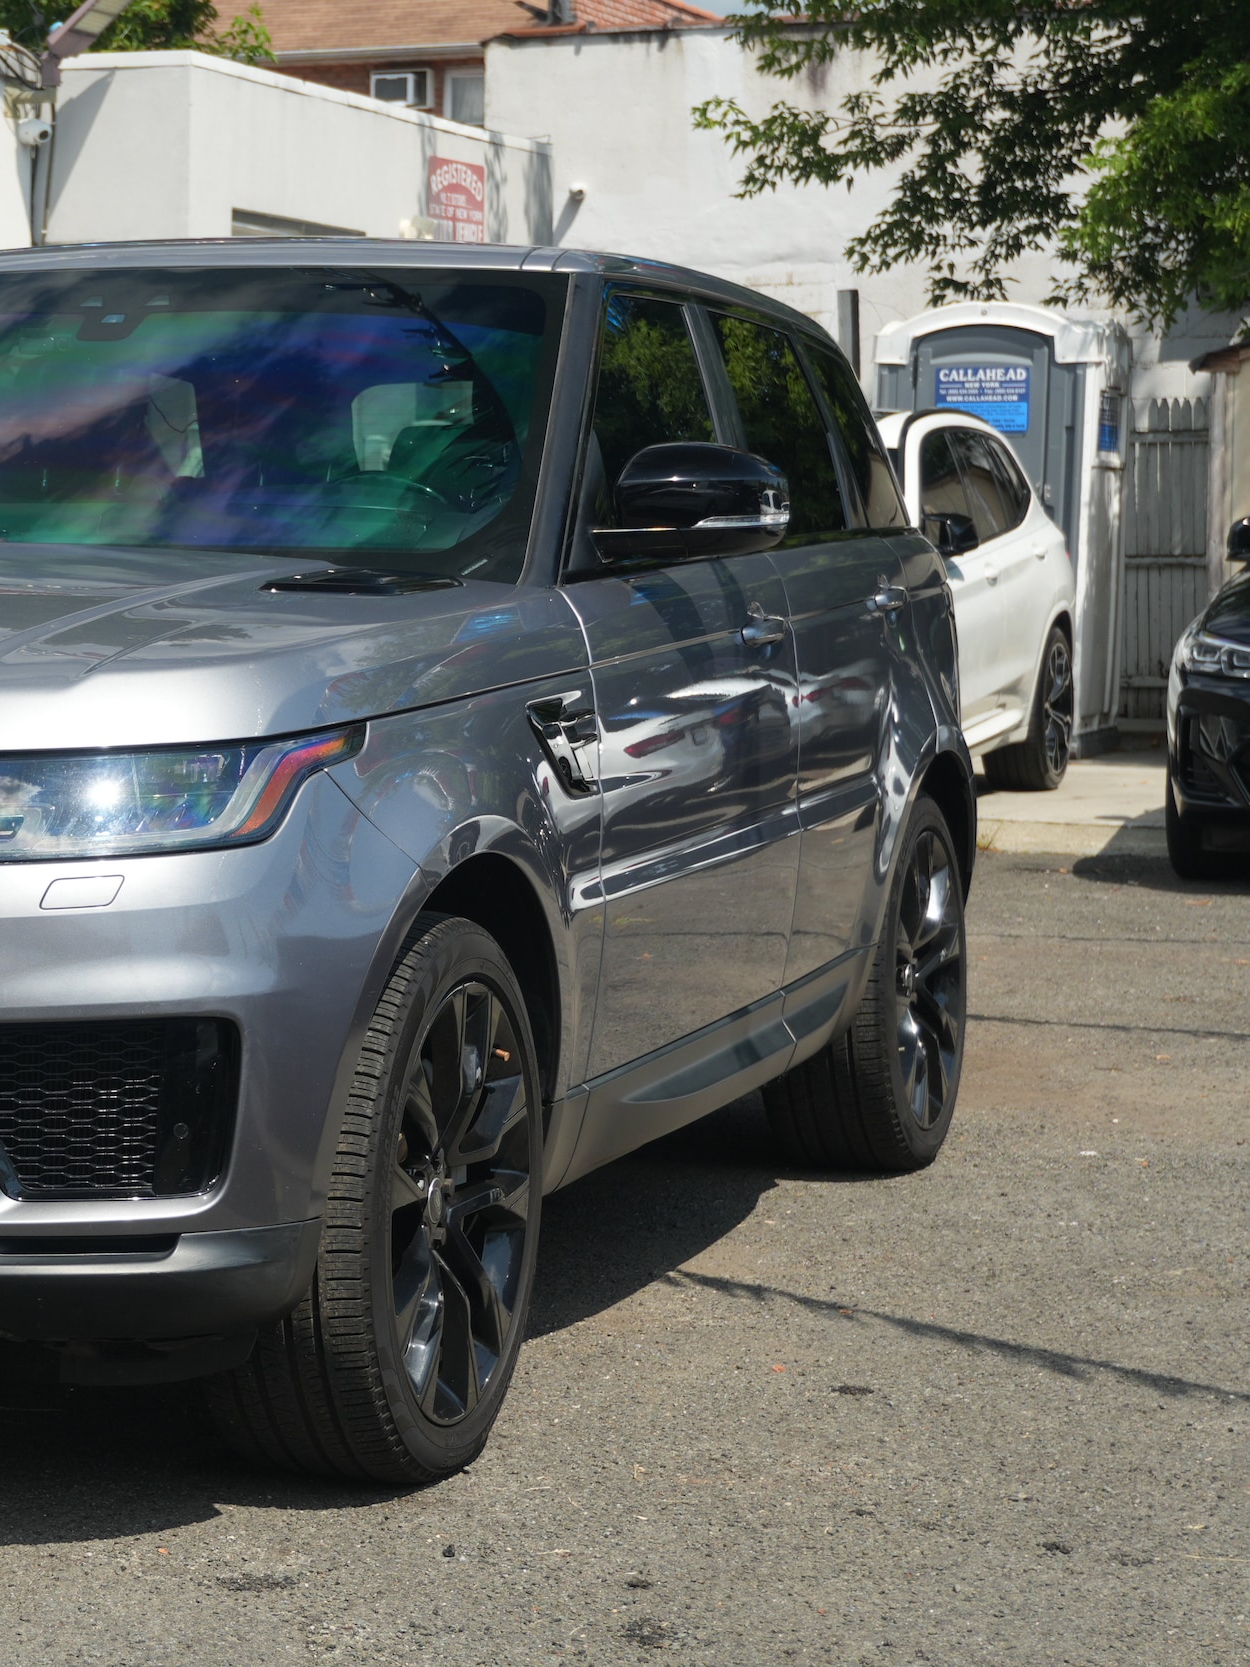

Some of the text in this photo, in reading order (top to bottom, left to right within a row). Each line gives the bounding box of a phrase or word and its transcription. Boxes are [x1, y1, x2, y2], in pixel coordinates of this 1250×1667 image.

[430, 162, 483, 202] REGISTERED
[939, 368, 1027, 382] CALLAHEAD
[946, 394, 1018, 402] WWW.CALLAHEAD.COM
